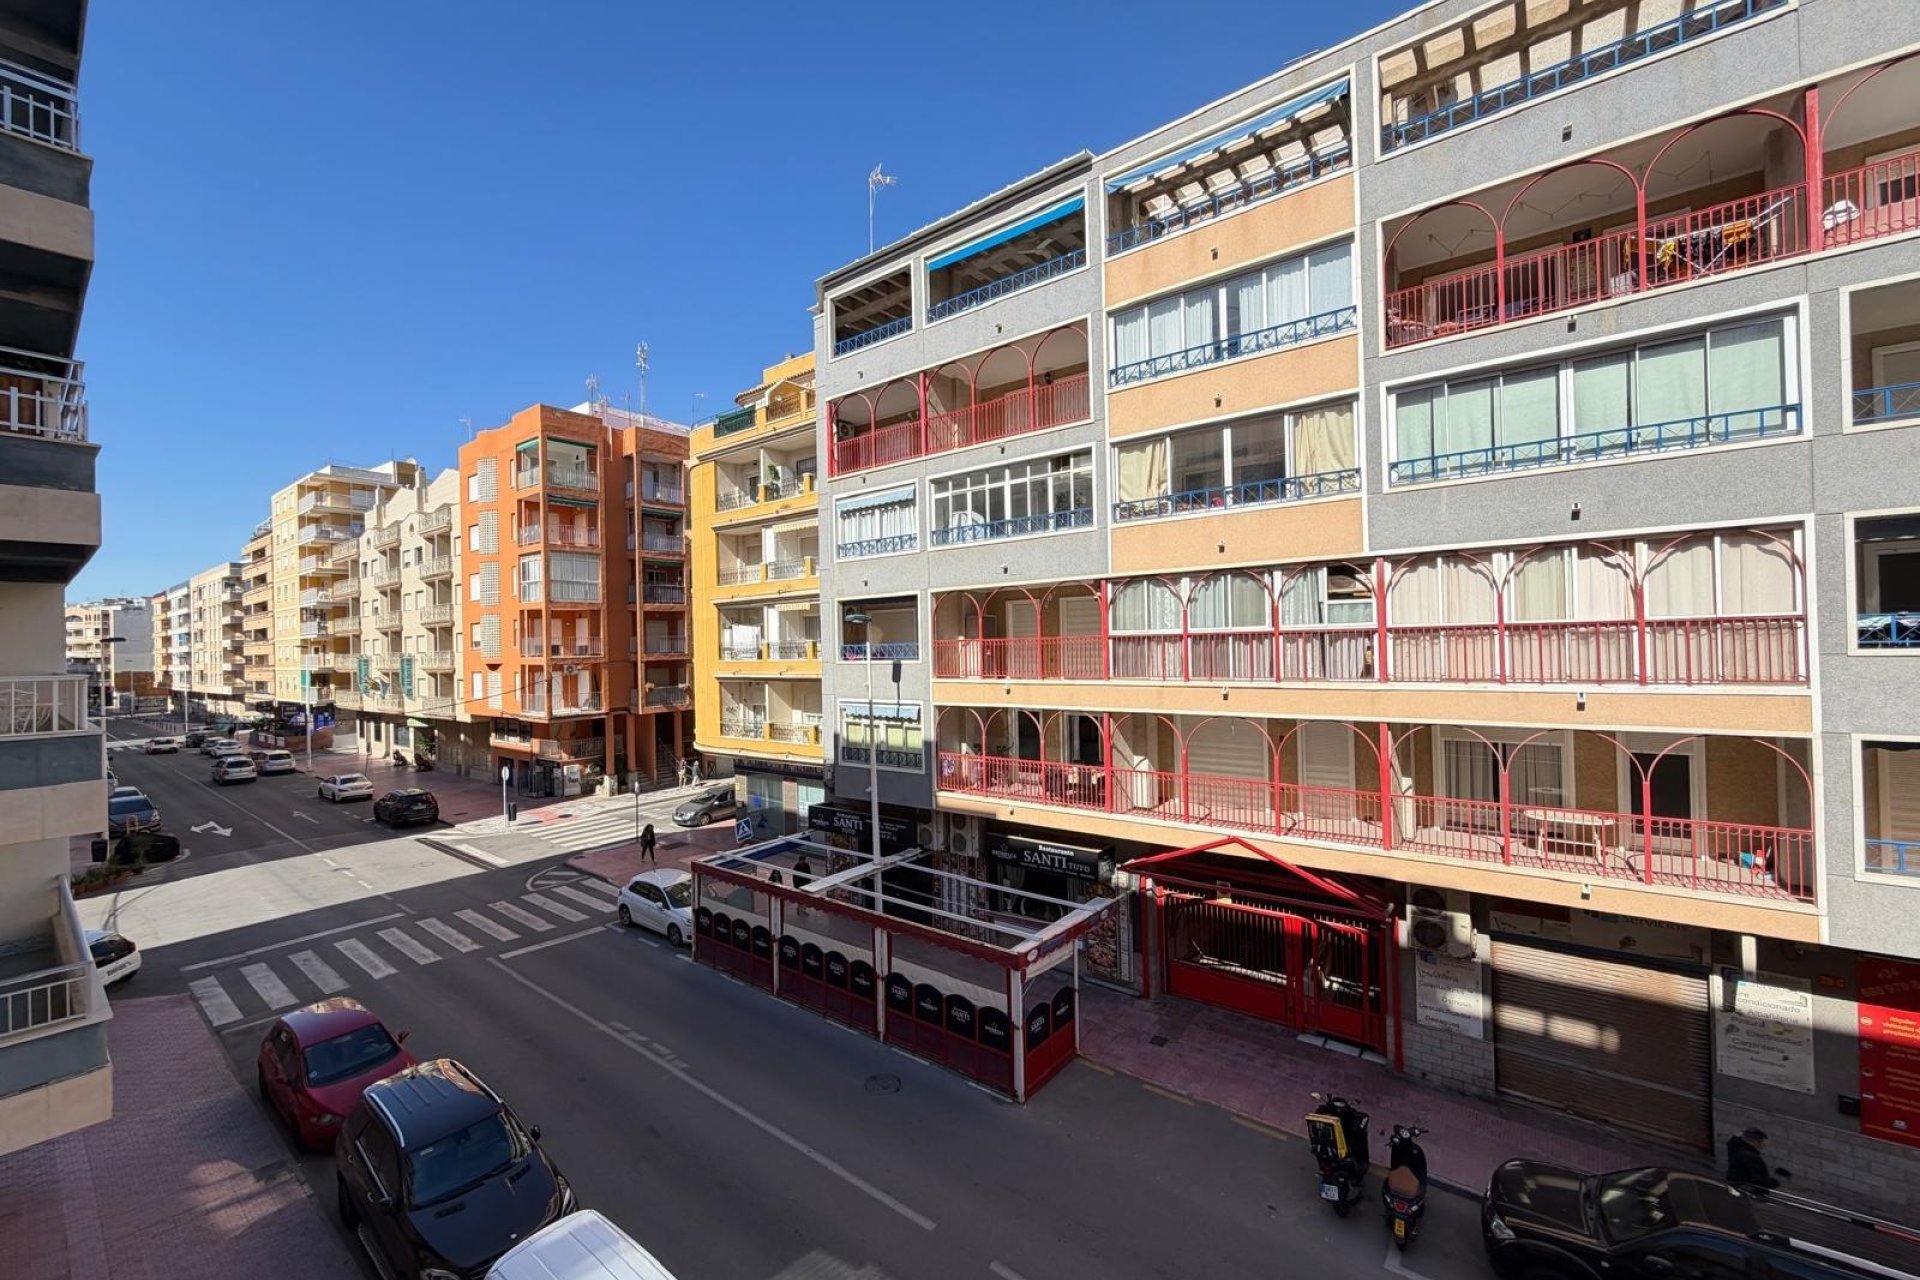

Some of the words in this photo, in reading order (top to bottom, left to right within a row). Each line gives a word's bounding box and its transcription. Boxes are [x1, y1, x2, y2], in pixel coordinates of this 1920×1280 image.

[833, 816, 863, 830] SANTI
[1038, 844, 1075, 857] Restaurante
[1023, 850, 1067, 869] SANTI
